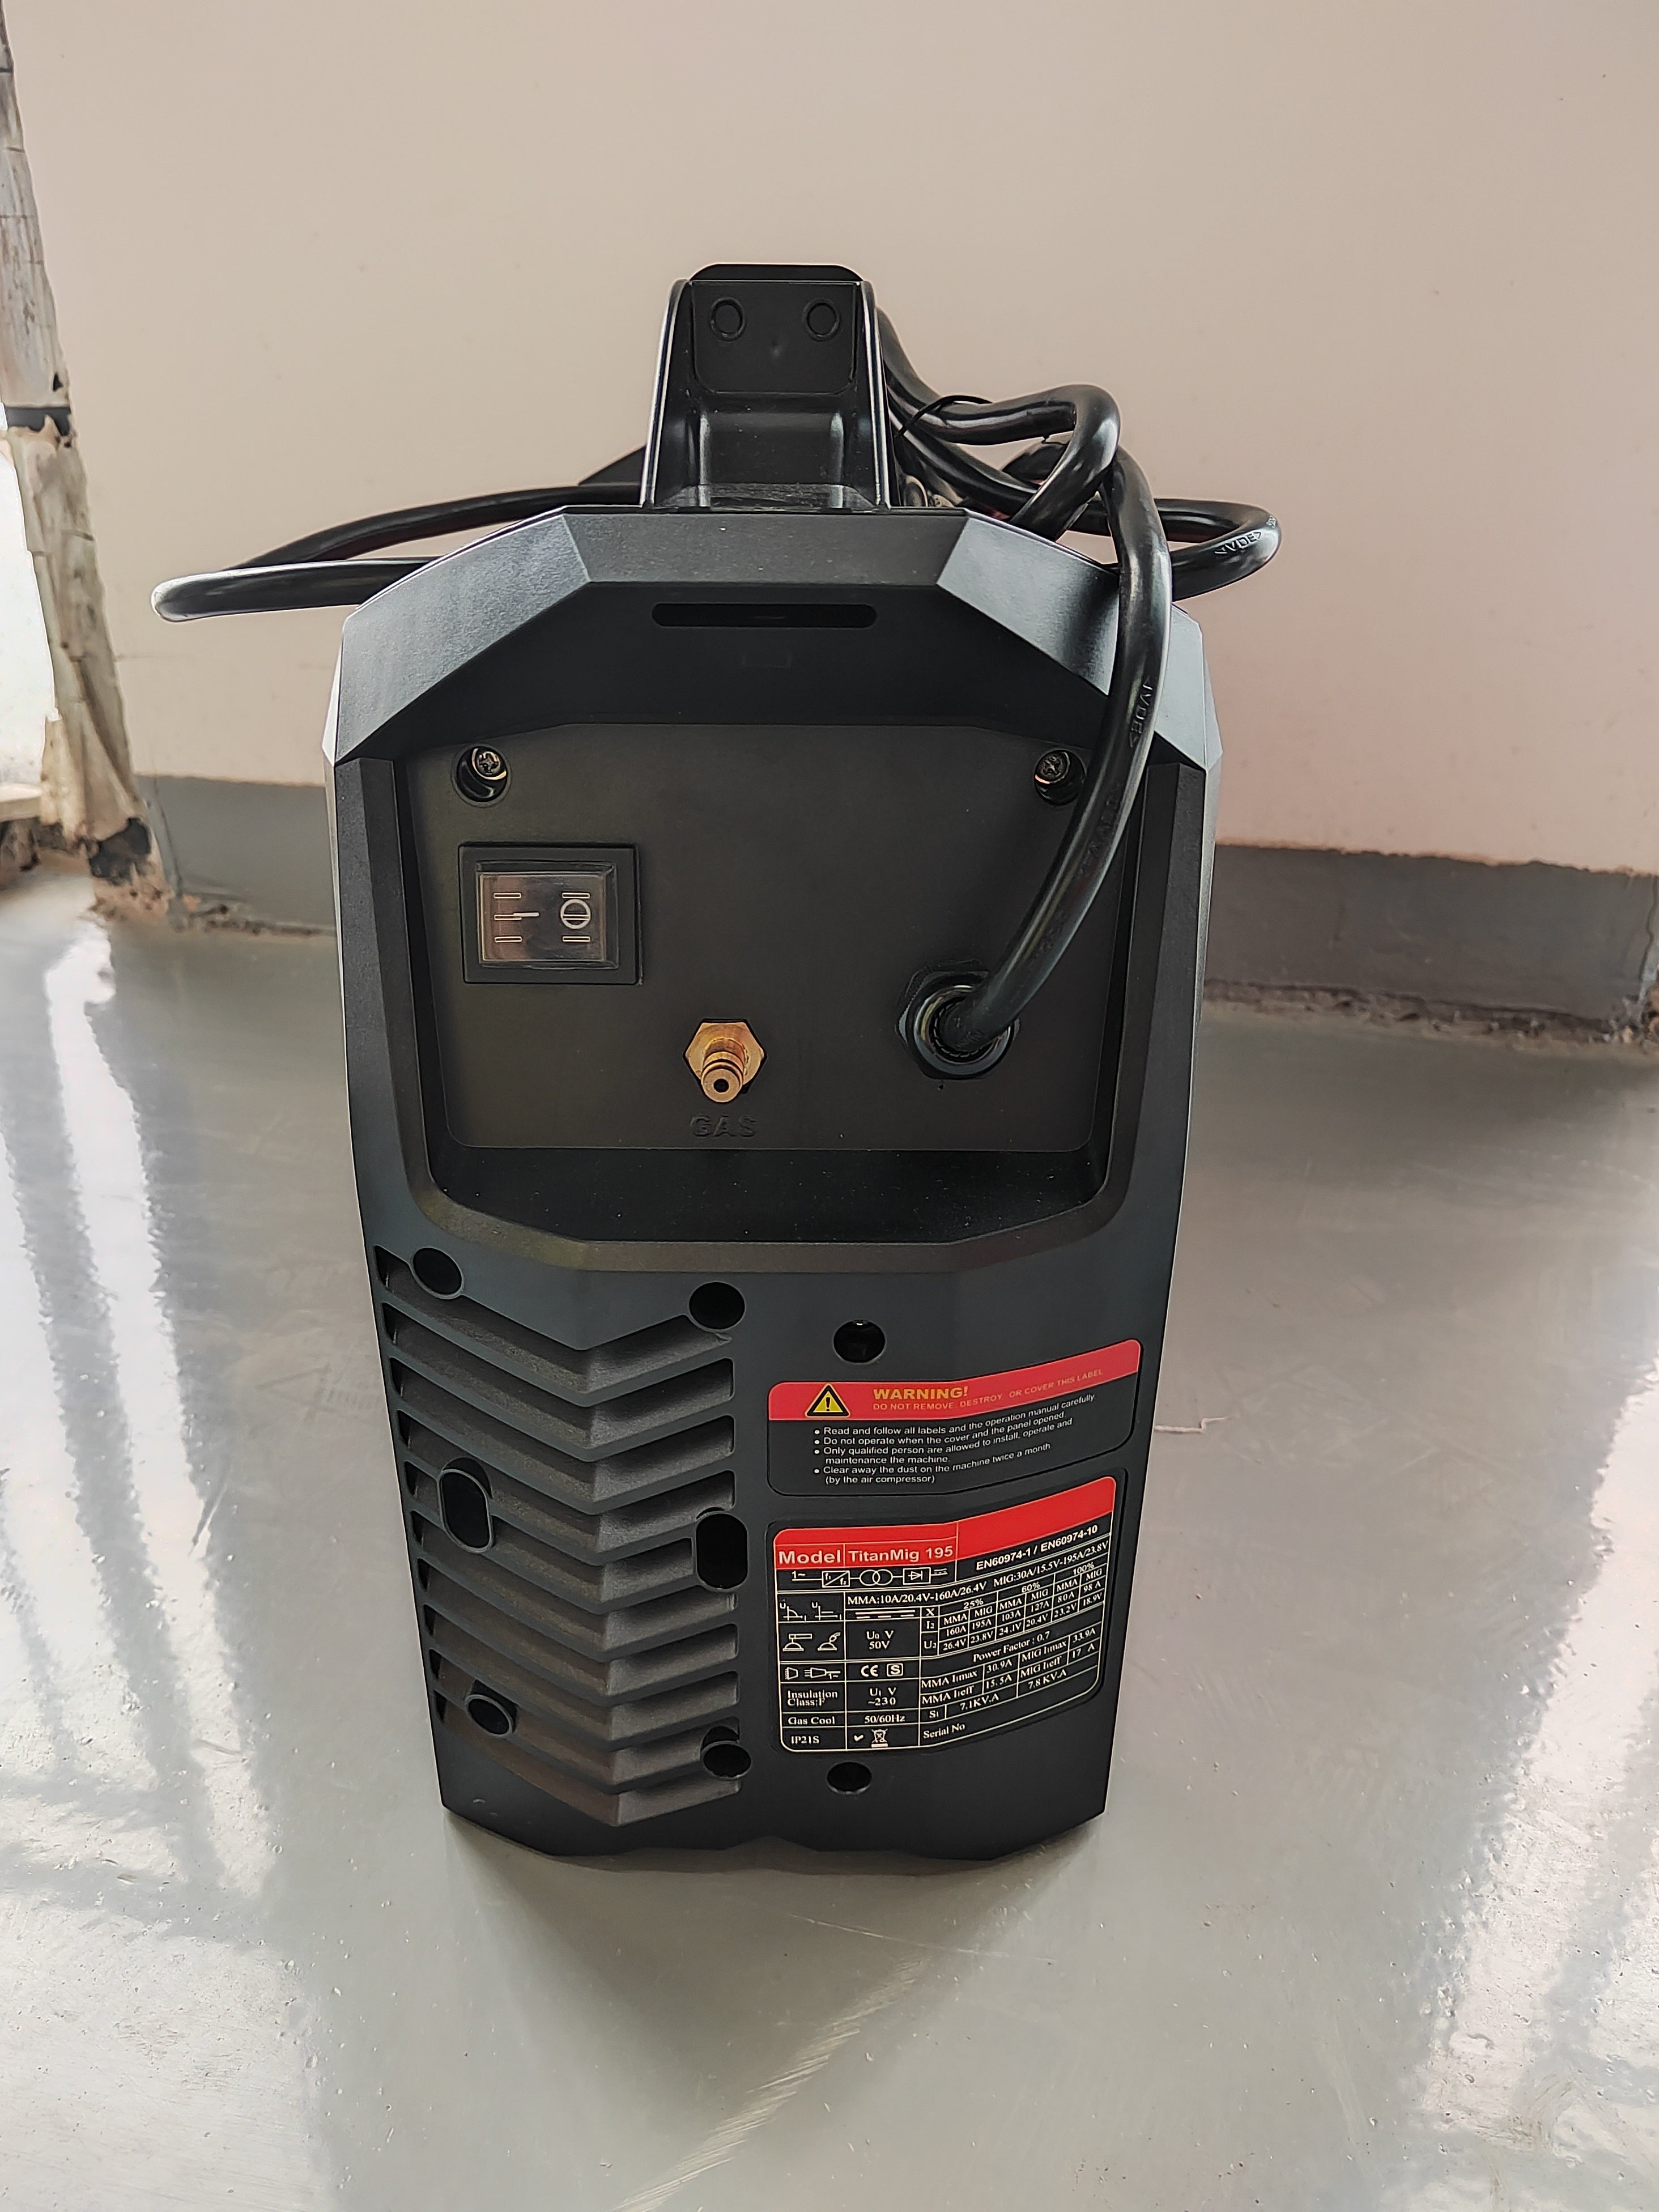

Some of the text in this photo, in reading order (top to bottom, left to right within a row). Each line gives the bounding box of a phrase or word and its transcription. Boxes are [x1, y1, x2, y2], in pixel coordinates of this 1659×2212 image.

[690, 1114, 757, 1137] GAS
[873, 1386, 968, 1399] WARNING!
[1024, 1381, 1054, 1395] COVER
[1057, 1376, 1075, 1387] THIS
[1077, 1369, 1103, 1381] LABEL
[948, 1423, 967, 1433] and
[969, 1420, 983, 1430] the
[985, 1412, 1026, 1429] operation
[1028, 1403, 1060, 1417] manual
[823, 1447, 845, 1456] Only
[848, 1446, 888, 1456] qualified
[891, 1447, 924, 1456] person
[946, 1440, 980, 1453] allowed
[982, 1437, 991, 1447] to
[1023, 1424, 1055, 1438] operate
[1056, 1417, 1073, 1429] and
[858, 1437, 895, 1445] operate
[944, 1433, 970, 1444] cover
[972, 1428, 989, 1439] and
[992, 1427, 1005, 1436] the
[1007, 1422, 1031, 1437] panel
[852, 1467, 877, 1475] away
[952, 1457, 990, 1472] machine
[993, 1452, 1014, 1464] twice
[1024, 1443, 1051, 1456] month
[825, 1476, 841, 1485] (by
[876, 1475, 935, 1484] compressor)
[779, 1545, 954, 1564] Model TitanMig 195
[976, 1547, 1031, 1571] EN60974-1
[1040, 1524, 1099, 1552] EN60974-10
[943, 1568, 1103, 1626] MMA MIG MMA MIG MMA MIG
[963, 1598, 984, 1609] 25%
[1021, 1581, 1041, 1593] 60%
[1072, 1562, 1095, 1576] 100%
[946, 1625, 967, 1637] 160A
[972, 1618, 992, 1630] 195A
[1001, 1610, 1022, 1622] 103A
[1030, 1600, 1050, 1613] 127A
[869, 1640, 890, 1650] 50V
[943, 1638, 967, 1651] 26.4V
[970, 1631, 994, 1644] 23.8V
[998, 1622, 1022, 1636] 24.1V
[1026, 1613, 1049, 1628] 20.4V
[972, 1648, 1002, 1663] Power
[1003, 1638, 1031, 1654] Factor
[1036, 1630, 1050, 1643] 0.7
[921, 1677, 950, 1689] MMA
[1022, 1648, 1042, 1663] MIG
[787, 1689, 839, 1699] Insulation
[921, 1692, 951, 1704] MMA
[1020, 1664, 1041, 1679] MIG
[788, 1716, 836, 1725] Gas Cool
[864, 1713, 906, 1724] 50/60Hz
[922, 1722, 966, 1739] Serial No
[791, 1735, 820, 1745] IP21S
